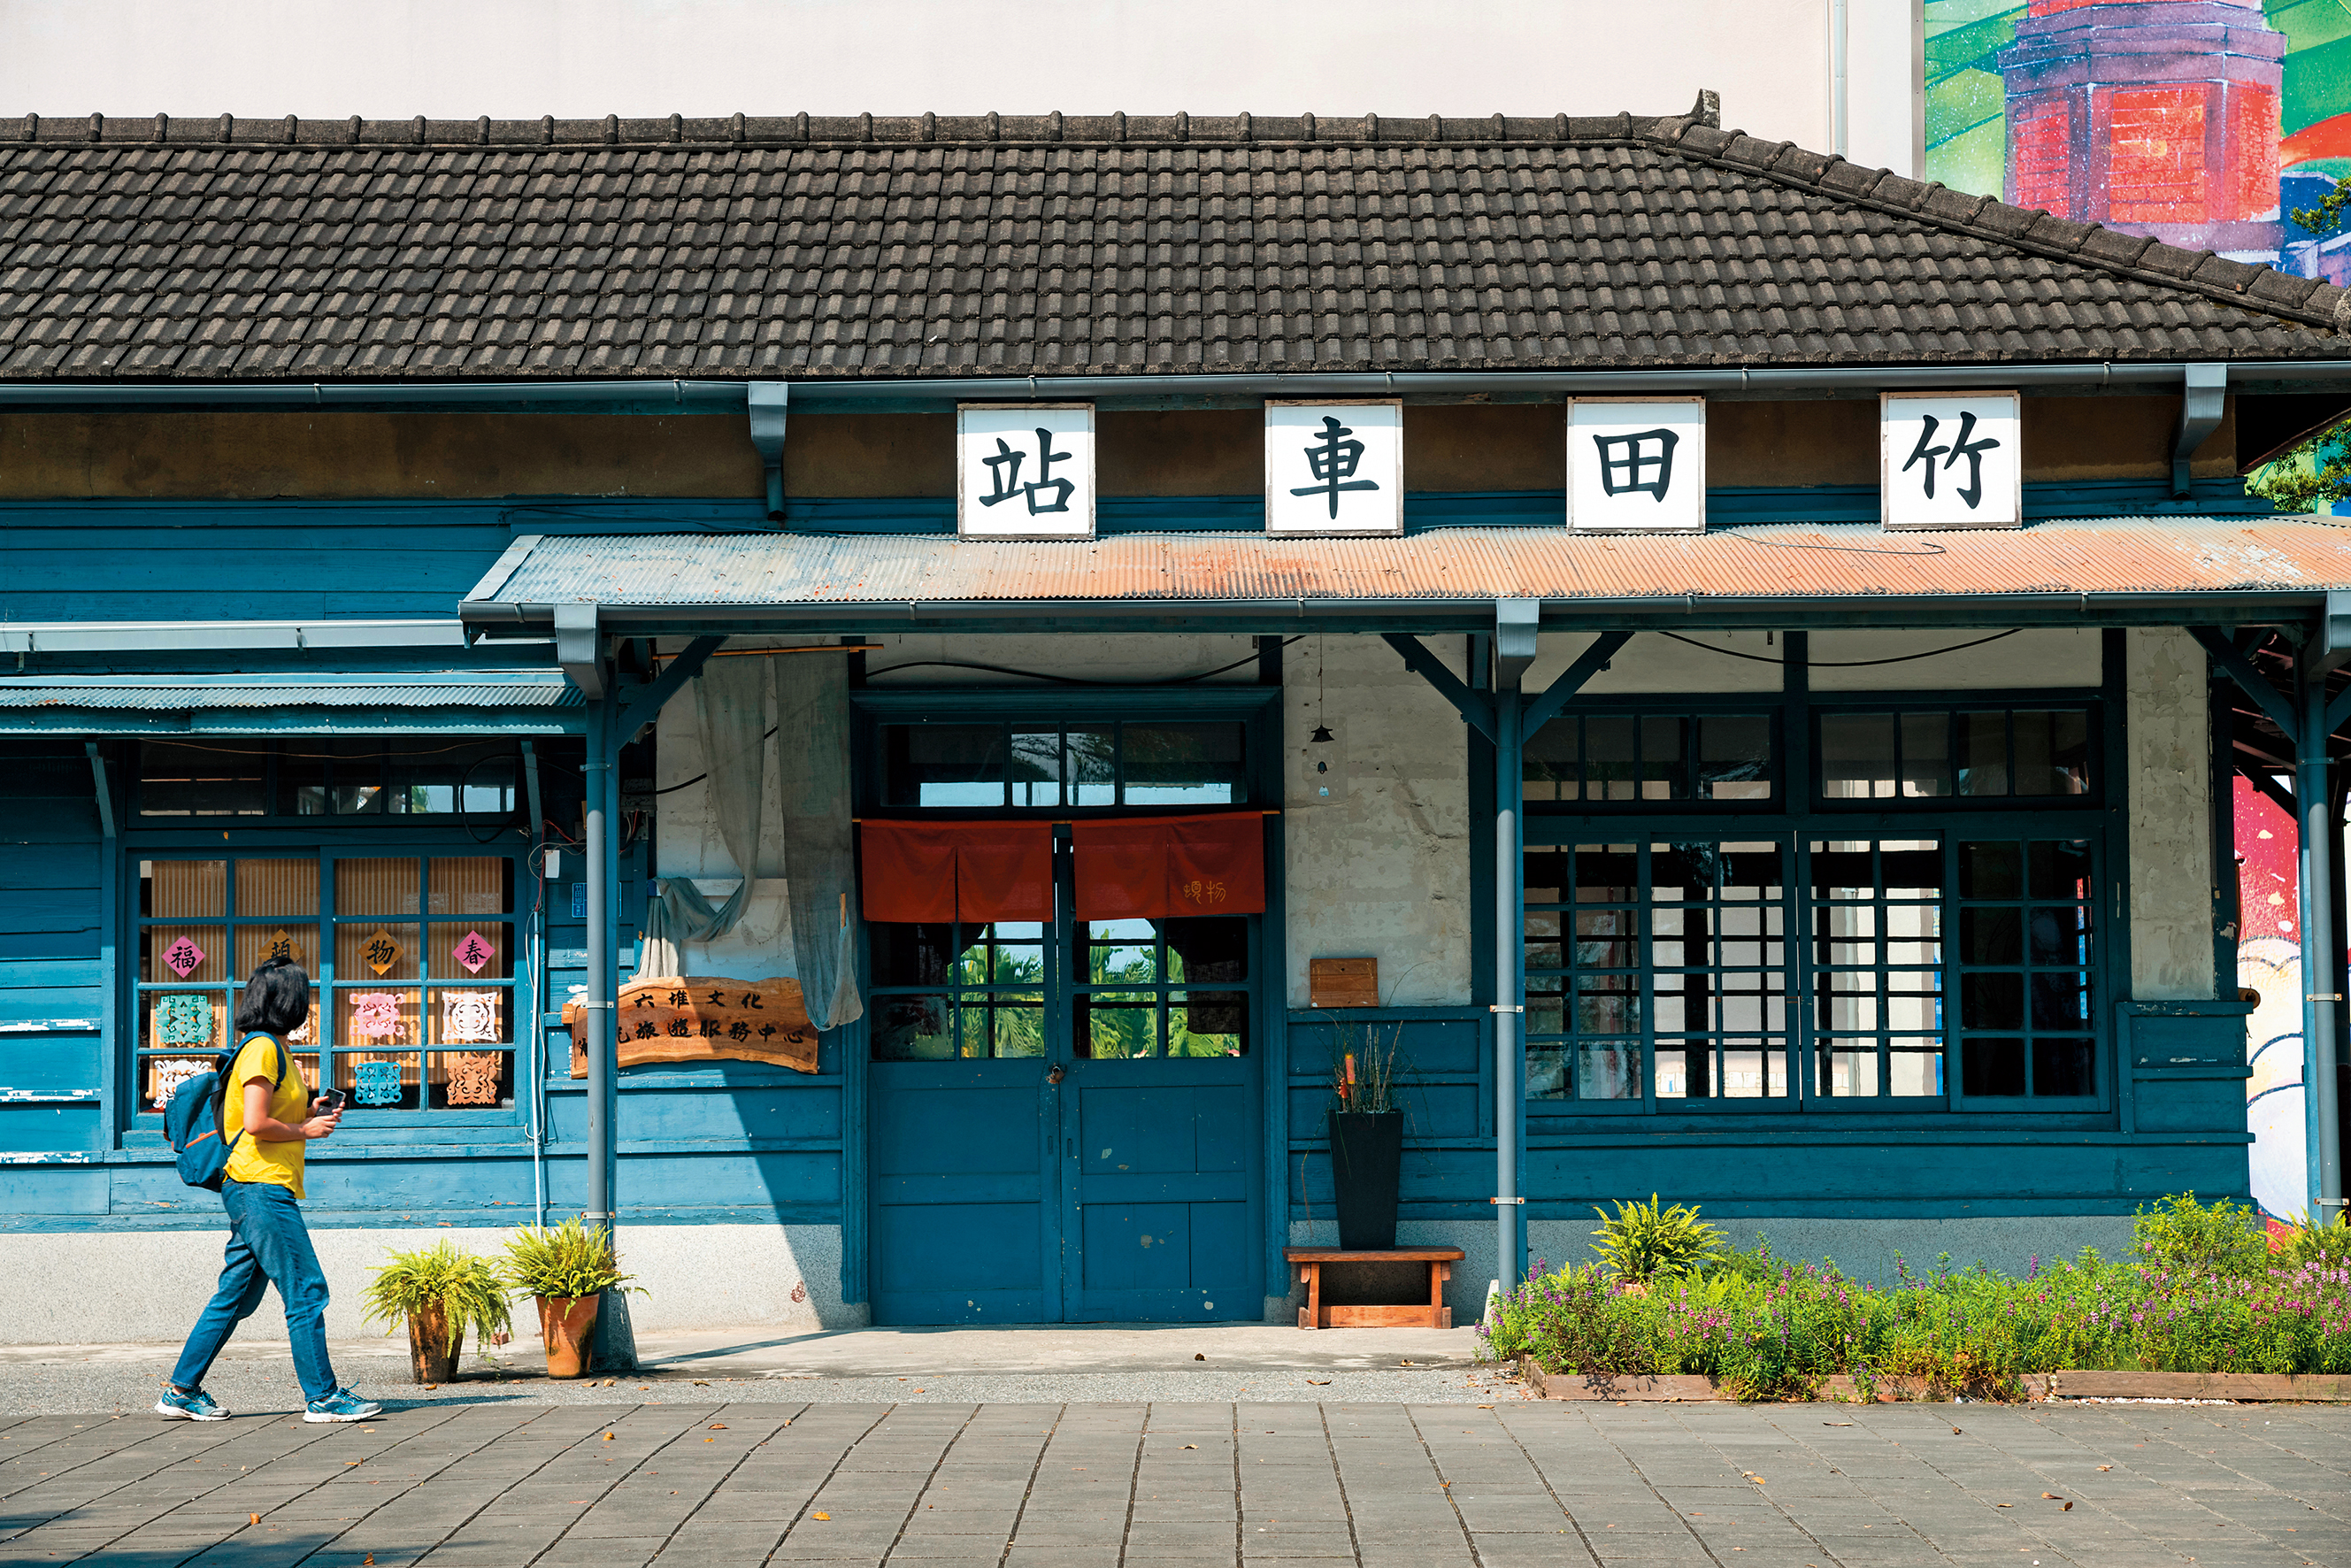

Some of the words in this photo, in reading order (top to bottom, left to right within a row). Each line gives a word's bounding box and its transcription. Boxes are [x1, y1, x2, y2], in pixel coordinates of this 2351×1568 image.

[979, 427, 1075, 516] 站
[1289, 415, 1380, 519] 車
[1593, 428, 1679, 503] 田
[1902, 411, 2001, 509] 竹
[170, 945, 196, 969] 福
[366, 940, 396, 965] 物
[463, 939, 487, 965] 春
[634, 989, 764, 1011] 六堆文化
